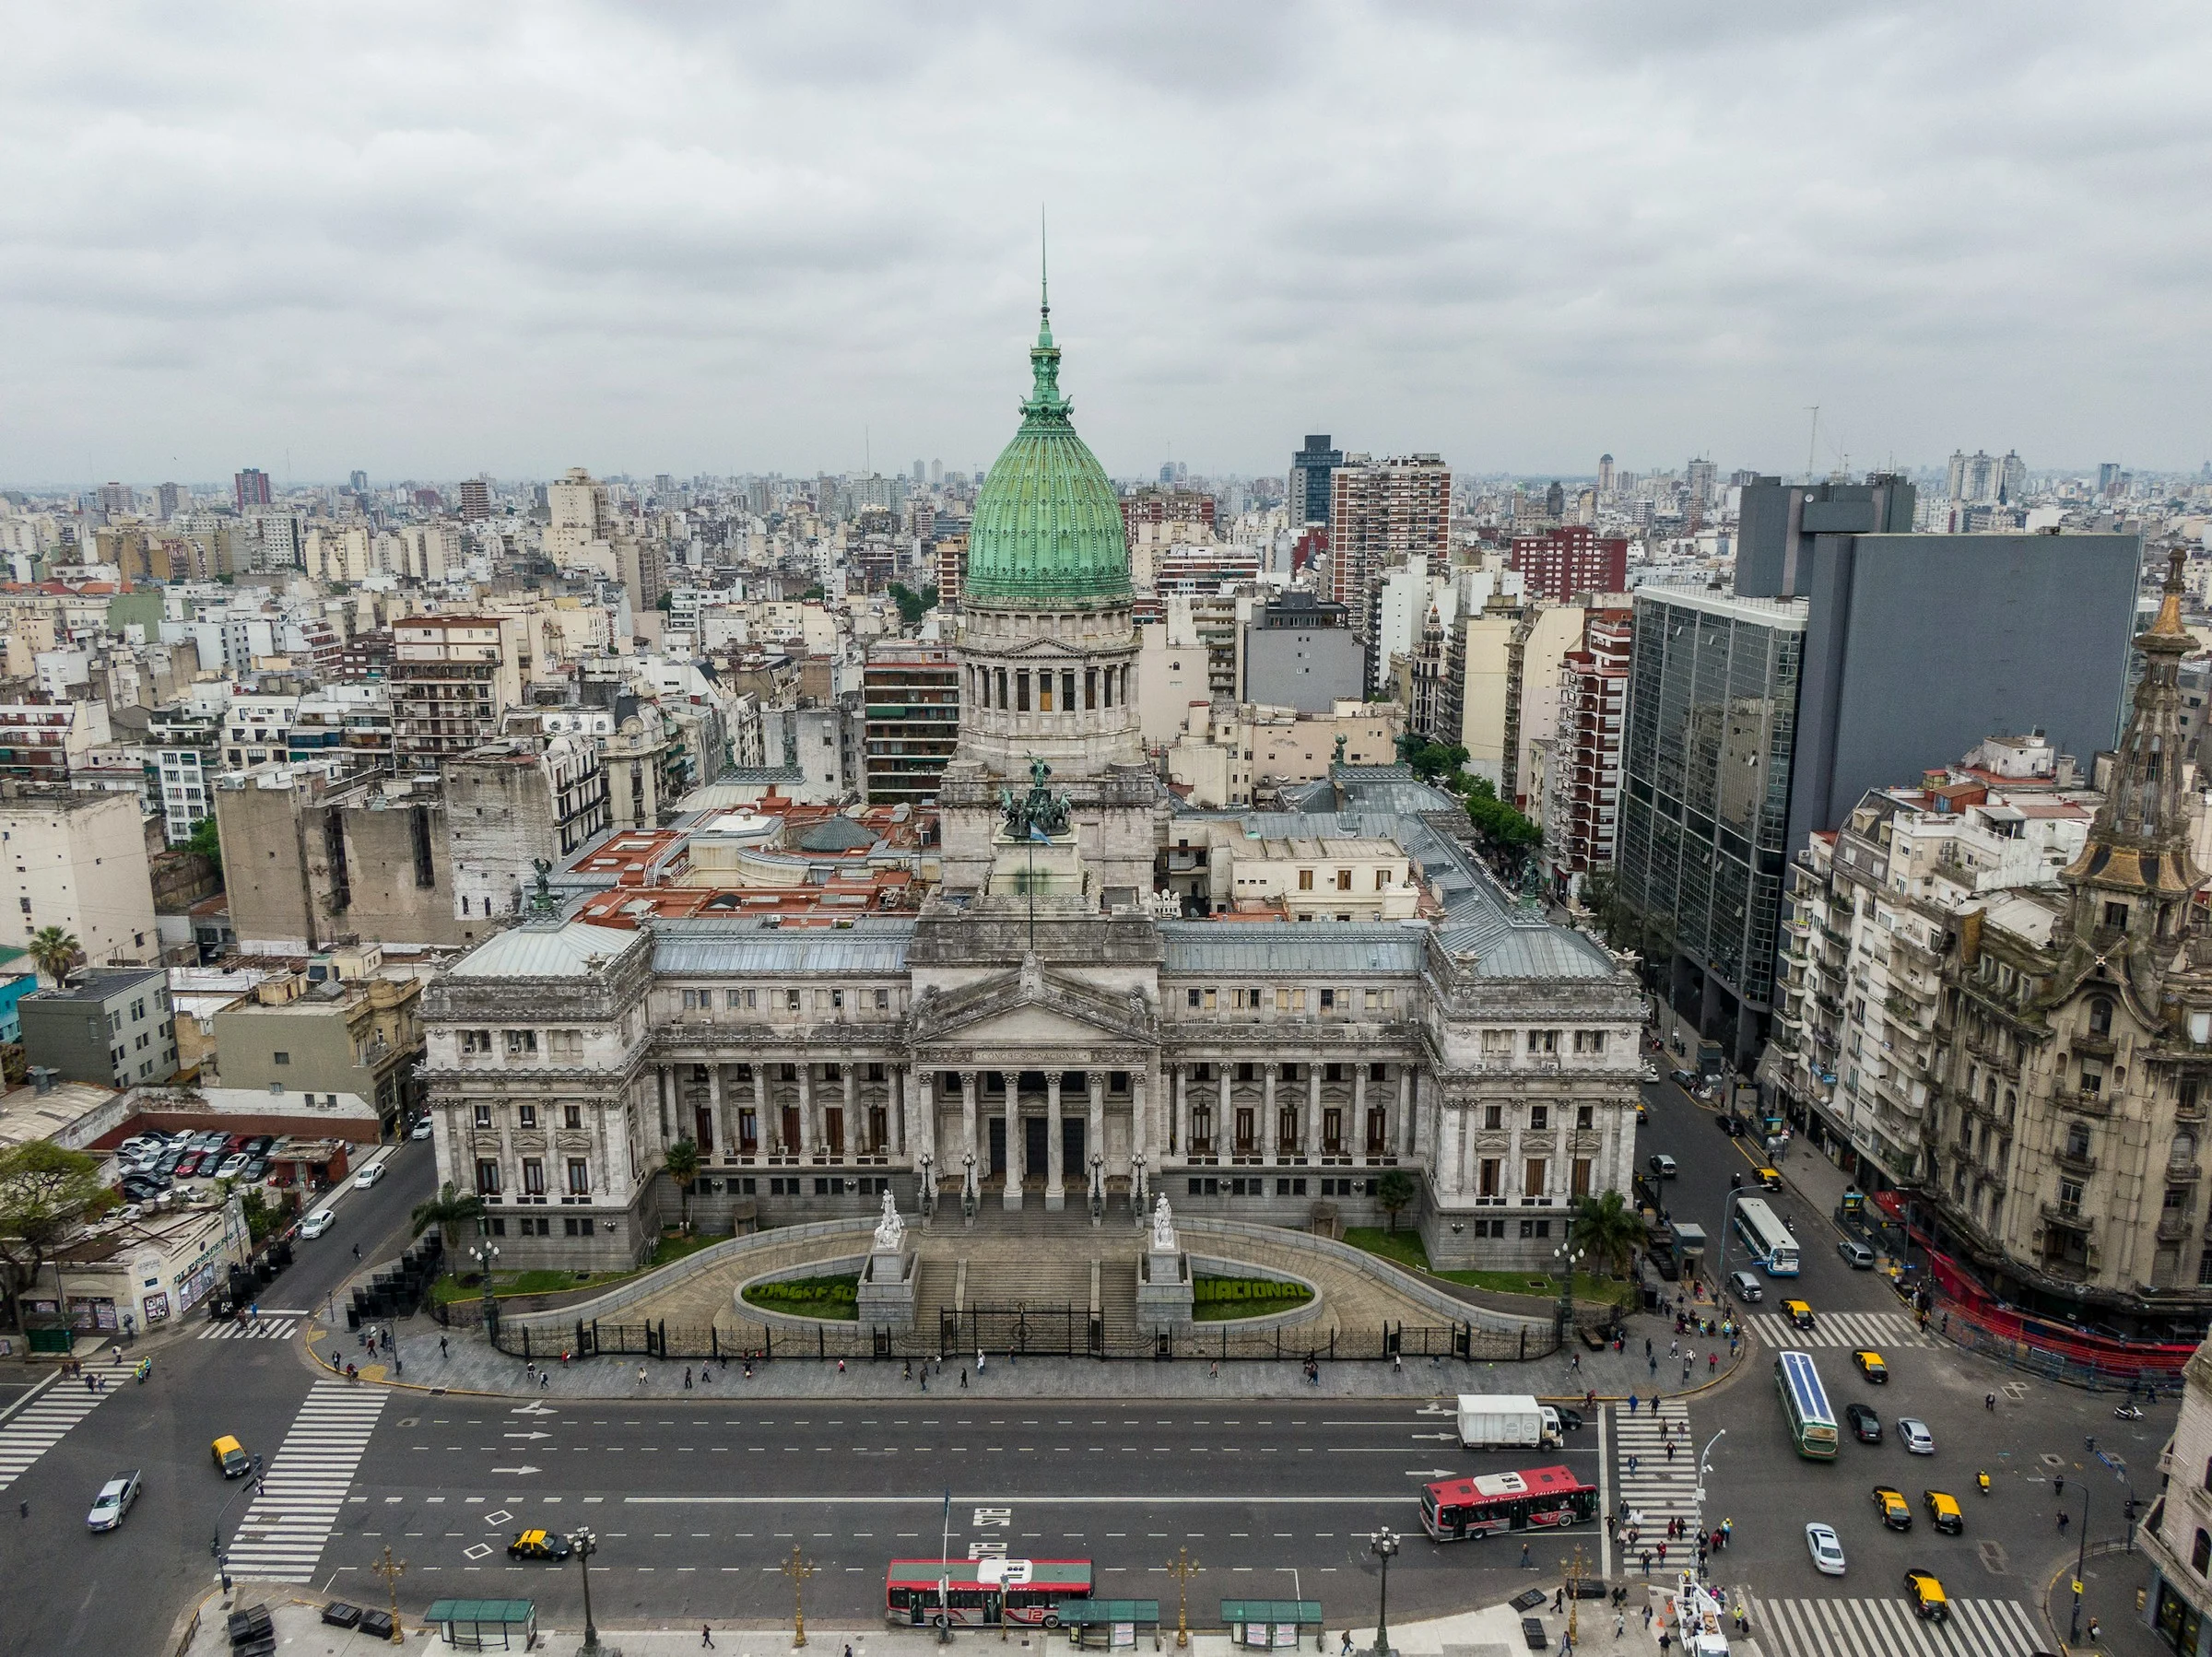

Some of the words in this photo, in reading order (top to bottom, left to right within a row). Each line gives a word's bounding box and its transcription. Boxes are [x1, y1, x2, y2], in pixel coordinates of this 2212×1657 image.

[981, 1052, 1032, 1061] CONGRESO
[1037, 1052, 1083, 1061] NACIONAL
[1194, 1280, 1312, 1300] NACIONAL
[972, 1508, 1012, 1526] BUS
[1547, 1512, 1559, 1521] 12
[1028, 1611, 1042, 1619] 12
